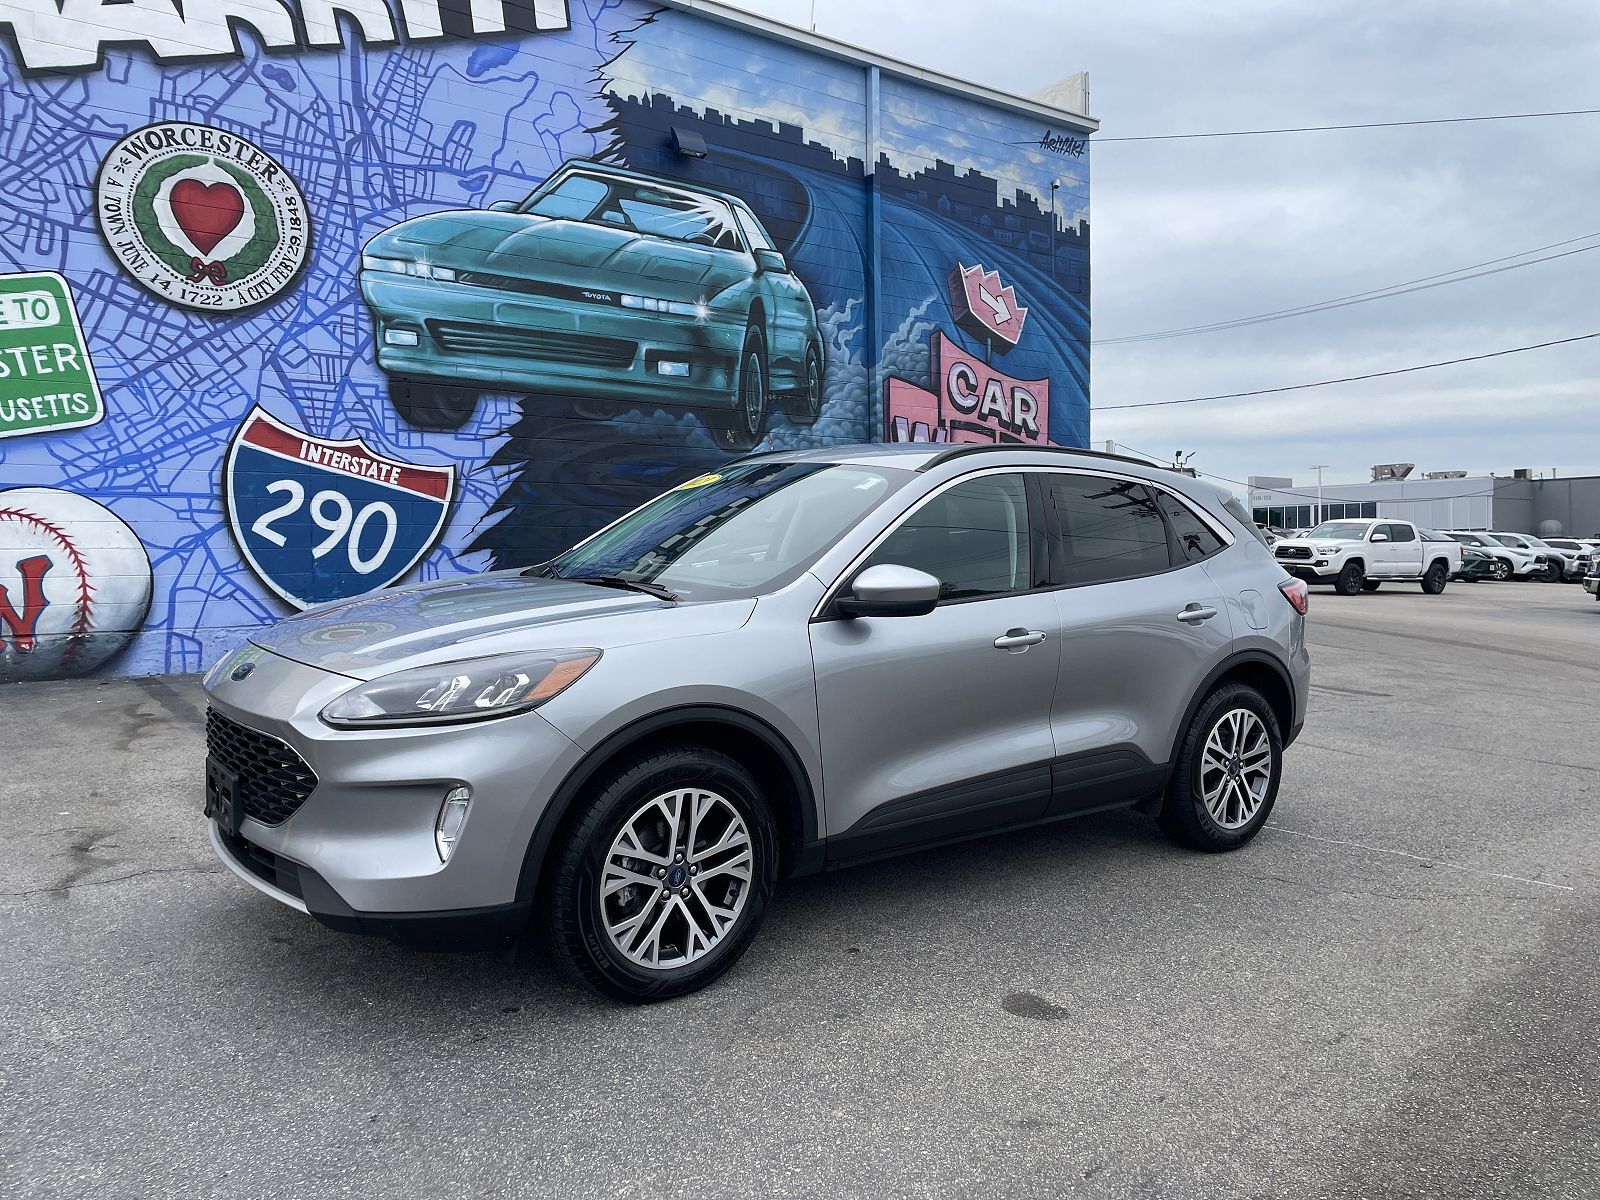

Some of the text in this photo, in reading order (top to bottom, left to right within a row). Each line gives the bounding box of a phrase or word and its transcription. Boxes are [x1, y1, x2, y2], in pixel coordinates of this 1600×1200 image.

[121, 127, 279, 185] WORCESTER
[107, 176, 123, 188] A
[103, 194, 128, 236] TOWN
[117, 240, 150, 274] JUNE
[179, 288, 223, 306] 1722
[237, 289, 249, 306] A
[247, 277, 276, 302] CITY
[582, 291, 611, 302] TOYOTA
[12, 297, 50, 321] TO
[947, 361, 1041, 441] CAR
[299, 440, 401, 486] INTERSTATE
[251, 479, 398, 575] 290
